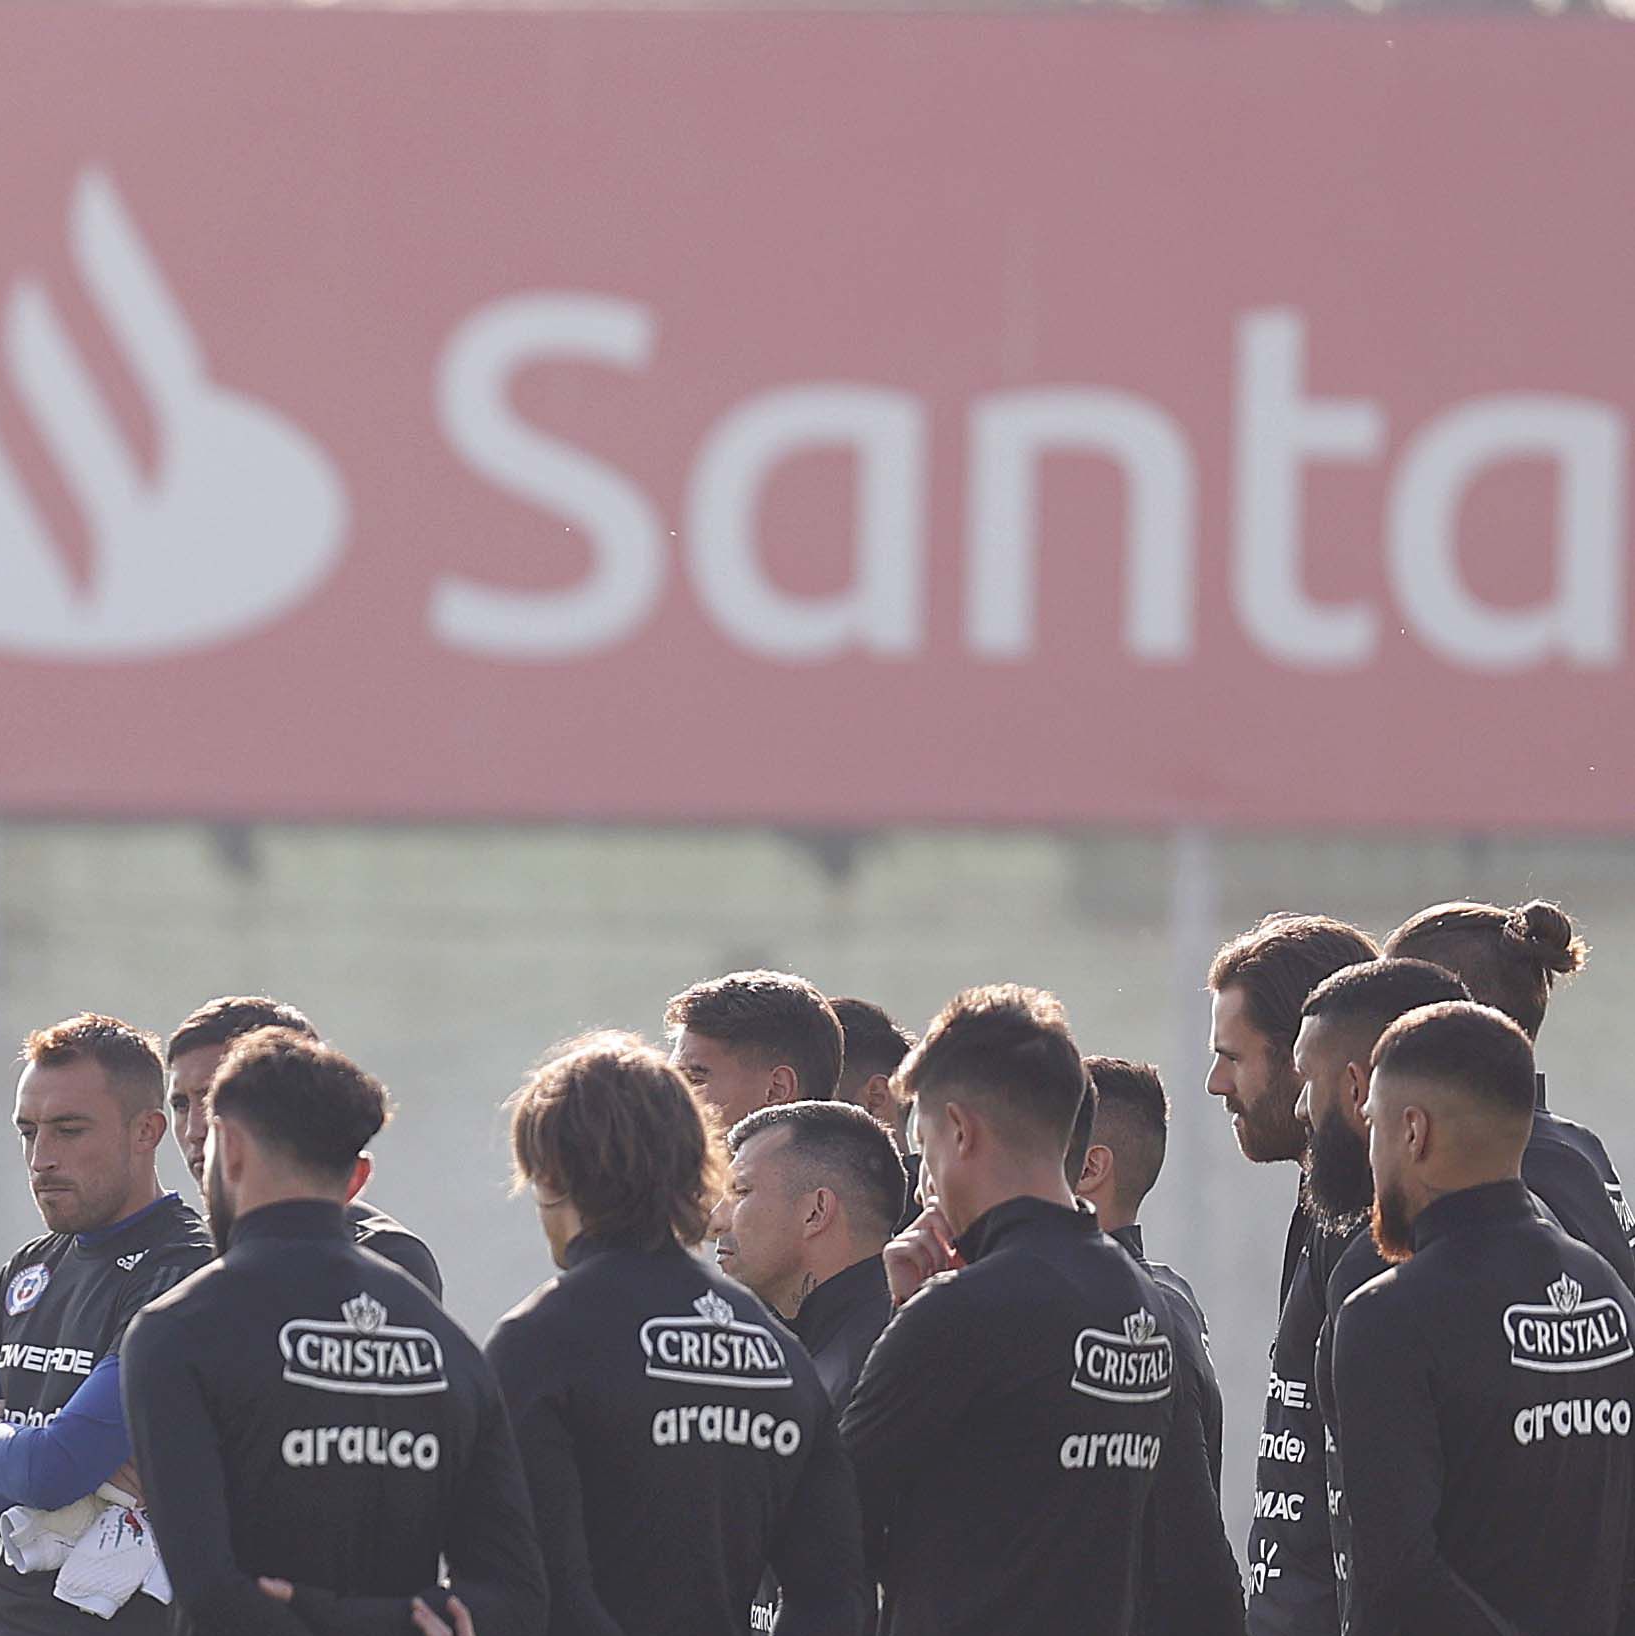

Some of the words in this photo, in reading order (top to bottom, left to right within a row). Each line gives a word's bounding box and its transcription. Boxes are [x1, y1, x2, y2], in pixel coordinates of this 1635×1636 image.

[429, 290, 1626, 668] Santa
[296, 1333, 429, 1377] CRISTAL
[656, 1329, 779, 1371] CRISTAL
[1518, 1316, 1619, 1357] CRISTAL
[1086, 1343, 1169, 1383] CRISTAL
[651, 1403, 802, 1457] arauco
[1514, 1397, 1631, 1445] arauco
[282, 1425, 440, 1471] arauco
[1060, 1432, 1161, 1470] arauco
